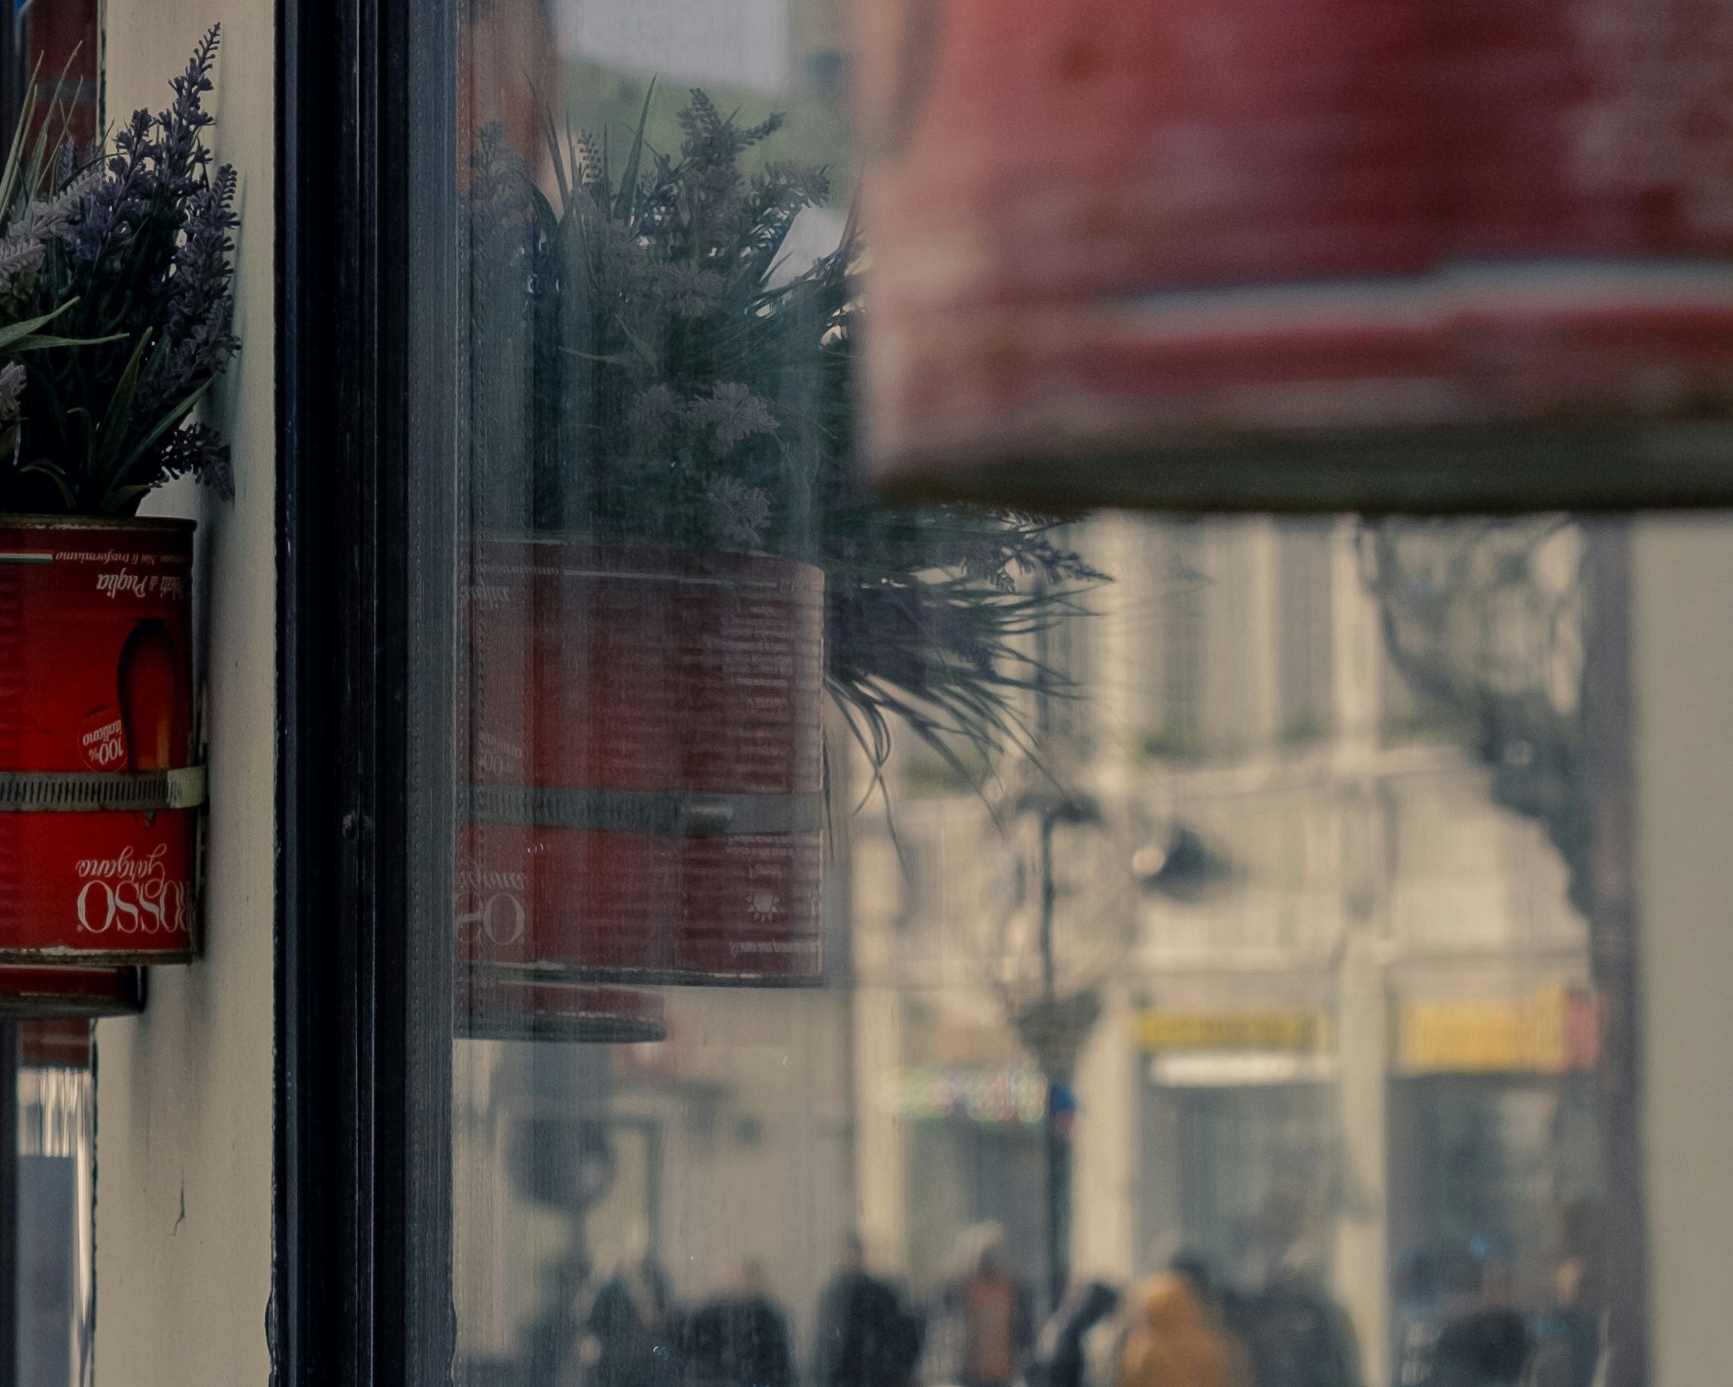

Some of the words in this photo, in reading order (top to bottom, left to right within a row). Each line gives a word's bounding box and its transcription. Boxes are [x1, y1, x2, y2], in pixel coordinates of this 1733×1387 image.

[55, 549, 130, 566] trasformiamo
[96, 567, 149, 600] Puglia
[83, 720, 123, 746] italiano
[88, 738, 124, 766] 100%
[75, 843, 167, 899] Gargano
[76, 880, 194, 935] ROSSO
